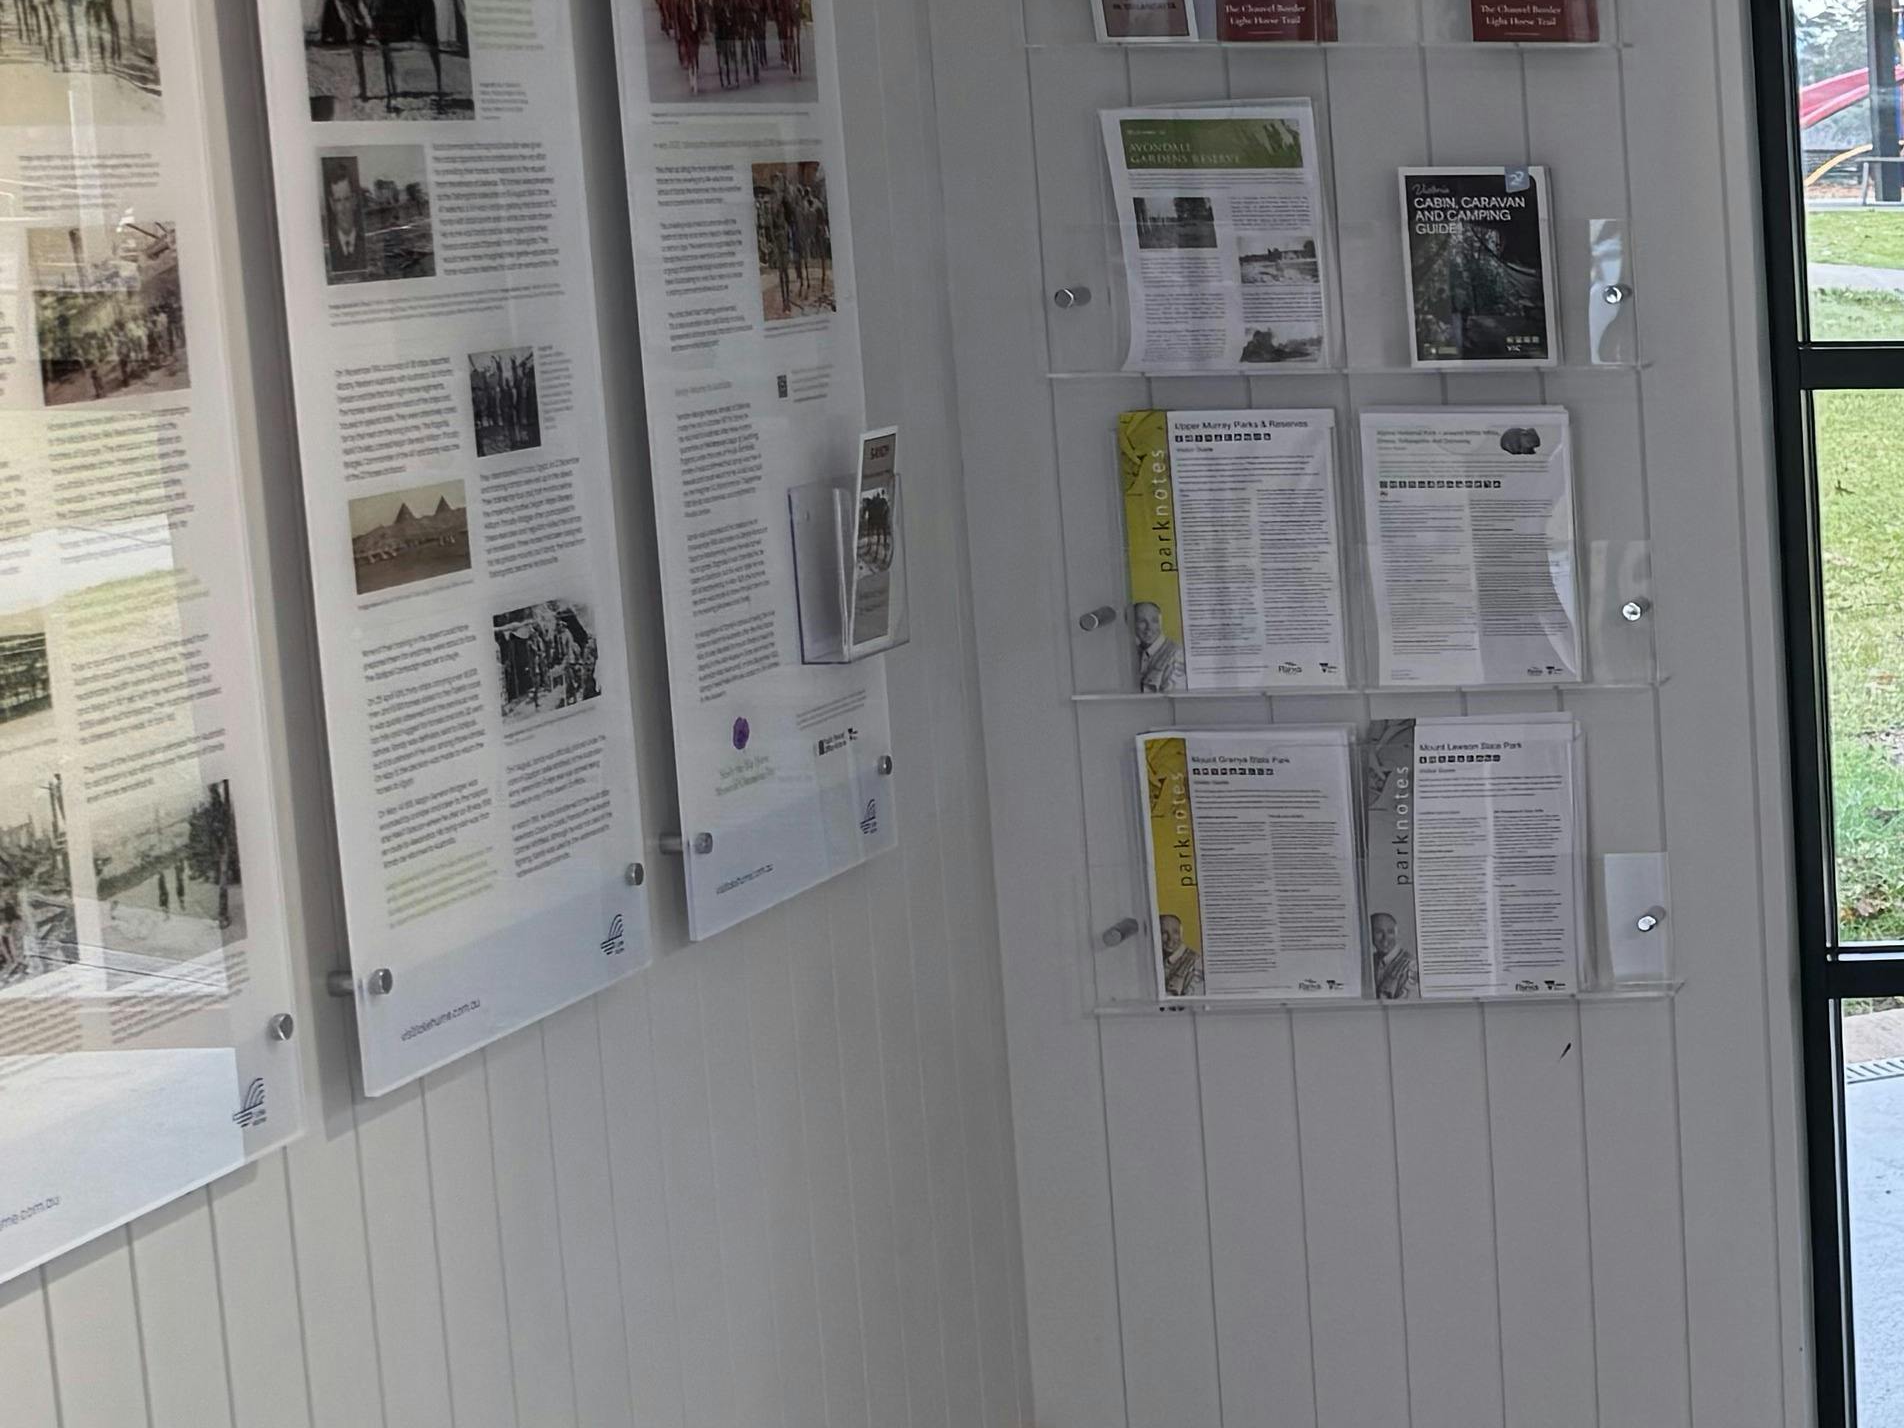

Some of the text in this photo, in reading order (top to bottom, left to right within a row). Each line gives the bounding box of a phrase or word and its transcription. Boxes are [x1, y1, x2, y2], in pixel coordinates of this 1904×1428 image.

[1414, 197, 1525, 209] CABIN, CARAVAN
[1415, 210, 1511, 221] AND CAMPING
[1416, 223, 1458, 234] GUIDE
[1152, 449, 1179, 573] parknotes
[1169, 772, 1198, 887] parknotes
[1392, 766, 1413, 886] parknotes
